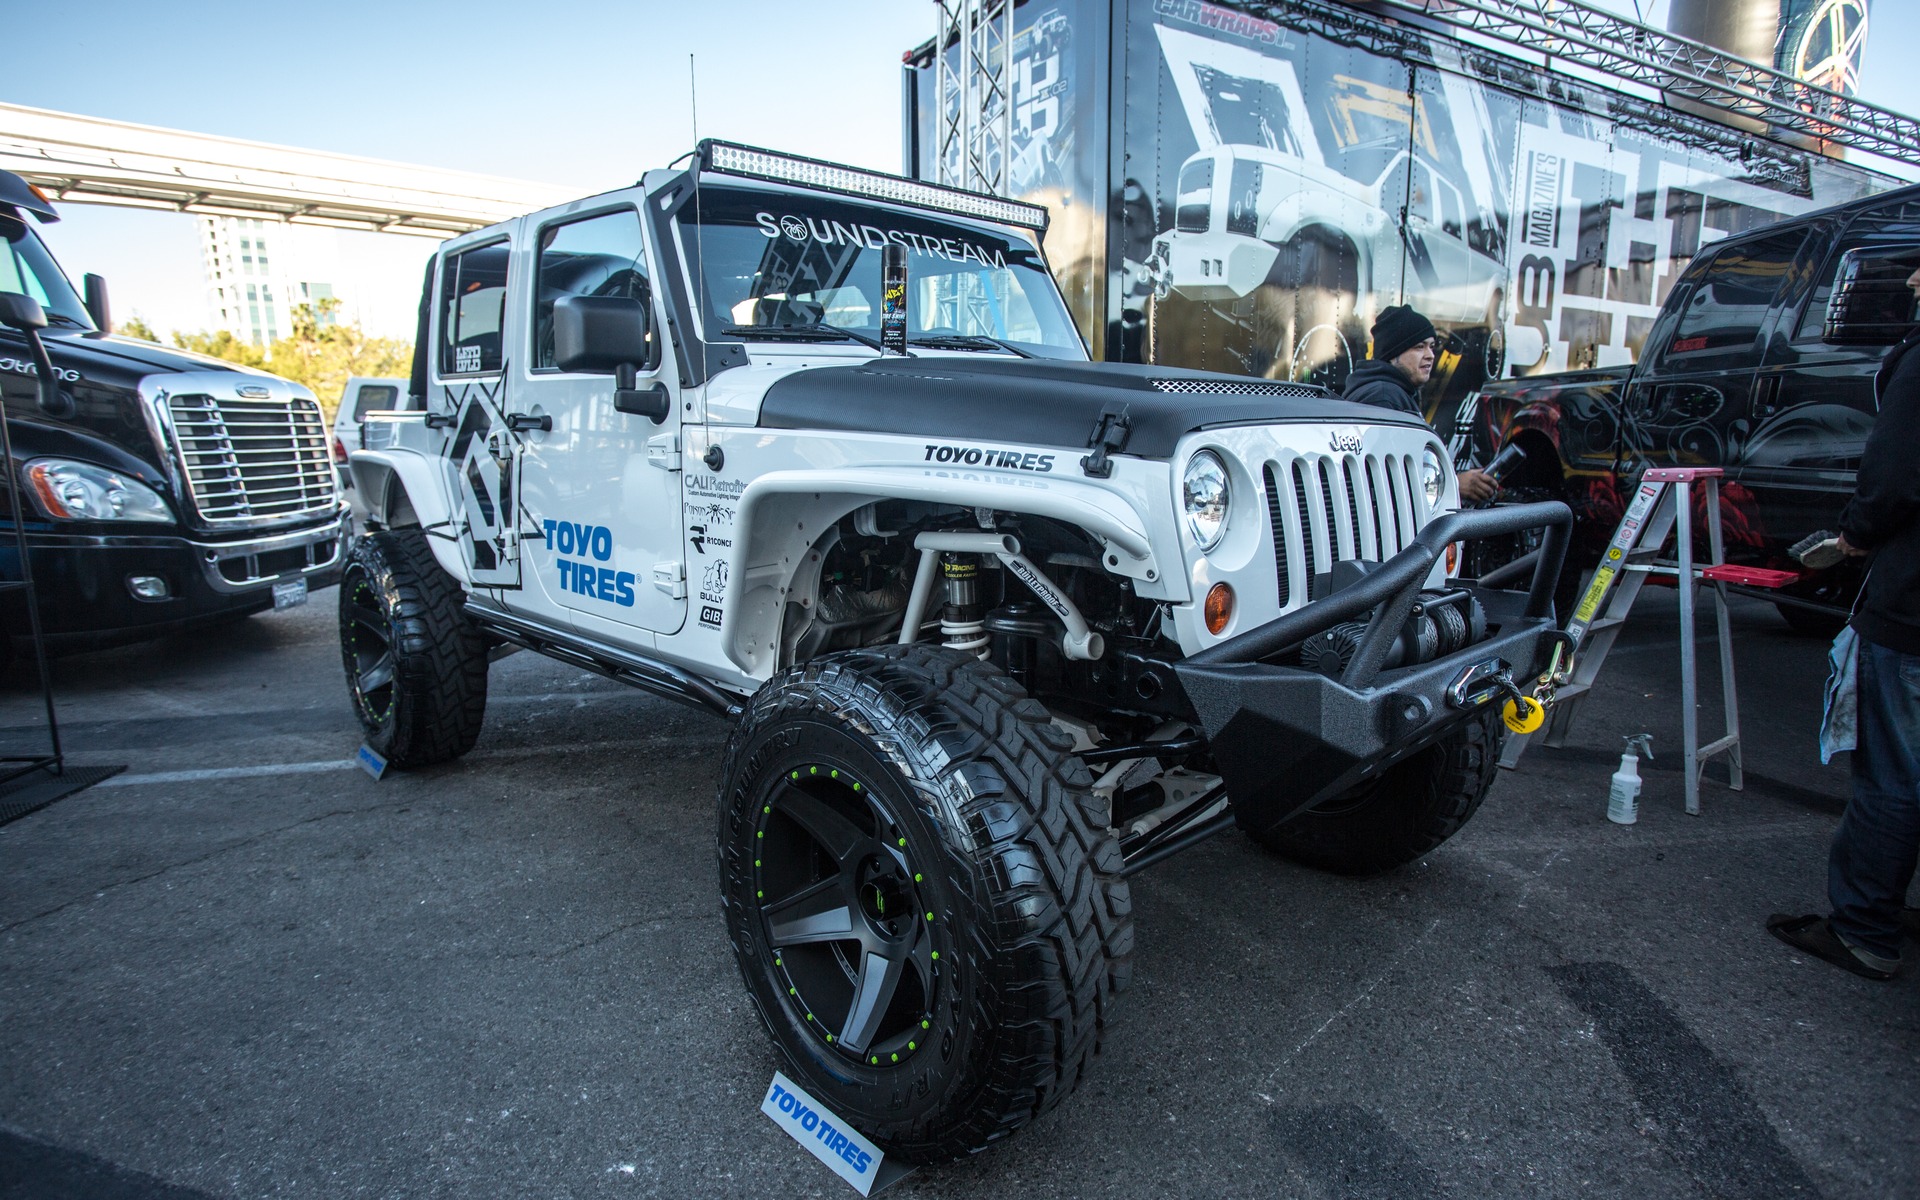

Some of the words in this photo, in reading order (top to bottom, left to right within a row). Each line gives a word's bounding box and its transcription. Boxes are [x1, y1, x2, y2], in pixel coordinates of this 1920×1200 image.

[1529, 153, 1557, 248] MAGAZINE'S
[925, 445, 983, 465] TOYO
[984, 449, 1055, 472] TIRES
[1329, 431, 1363, 455] Jeep
[543, 519, 612, 561] TOYO
[557, 558, 635, 607] TIRES
[700, 591, 724, 604] BULLY
[1016, 566, 1059, 608] BULLETPROOF
[703, 608, 722, 622] GIB
[769, 1083, 820, 1132] TOYO
[816, 1120, 873, 1174] TIRES
